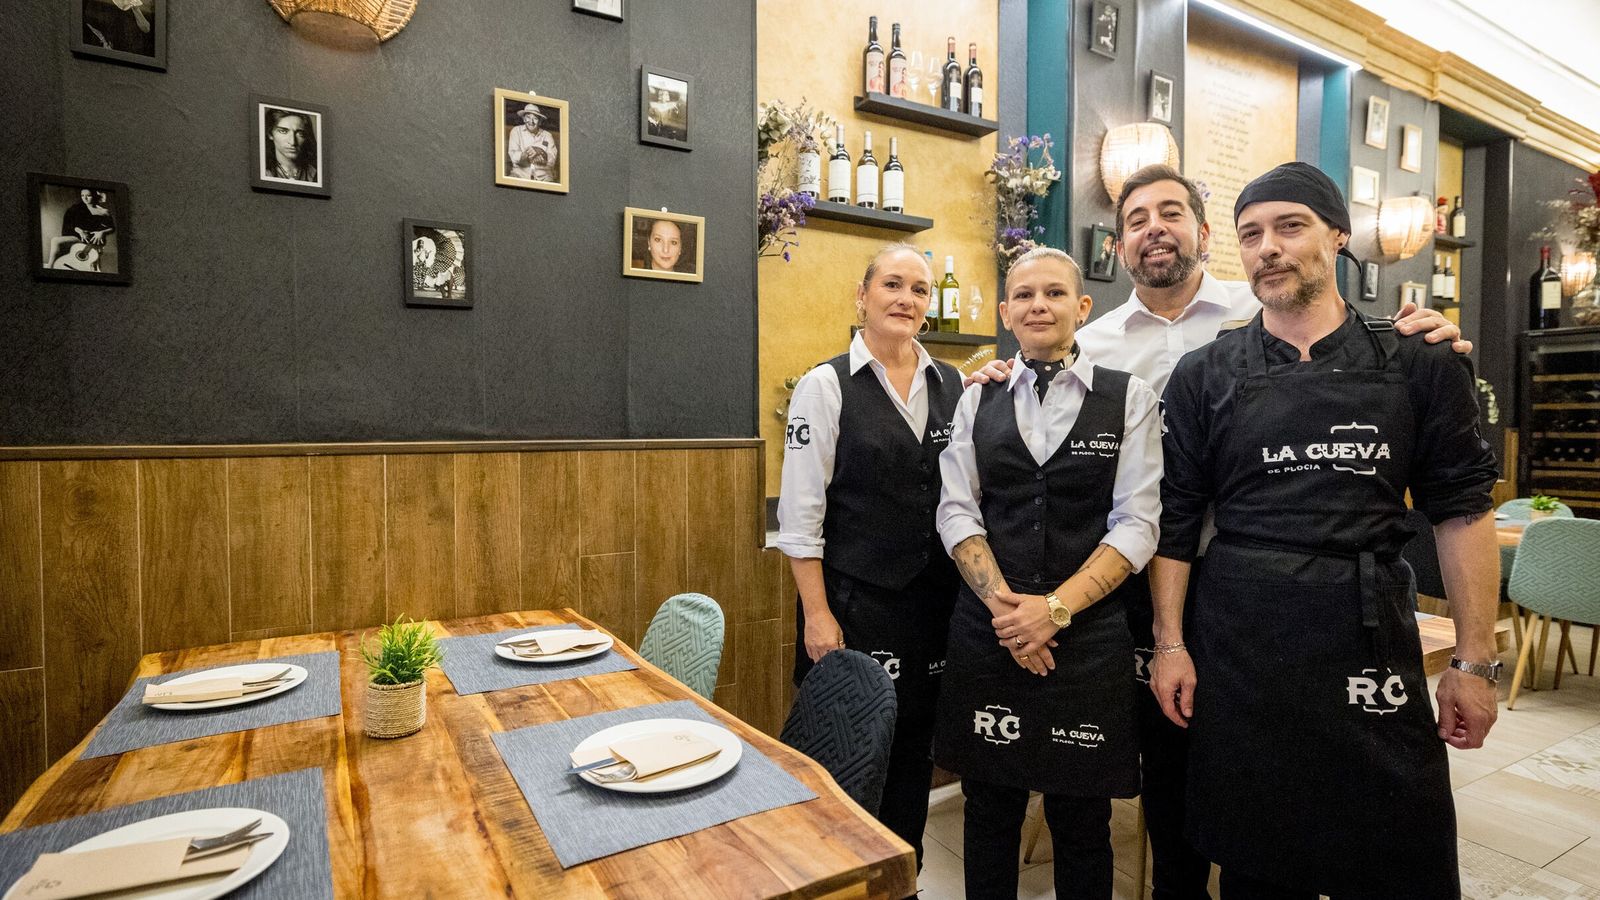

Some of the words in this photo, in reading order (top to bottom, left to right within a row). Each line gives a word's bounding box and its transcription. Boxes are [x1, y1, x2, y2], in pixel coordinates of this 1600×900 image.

[786, 424, 810, 445] RC
[1070, 440, 1086, 449] LA
[1089, 440, 1119, 450] CUEVA
[1262, 445, 1298, 463] LA
[1305, 442, 1391, 460] CUEVA
[1284, 463, 1321, 473] PLOCIA
[1346, 675, 1409, 706] RC
[973, 710, 1021, 740] RC
[1052, 727, 1066, 737] LA
[1069, 730, 1105, 742] CUEVA
